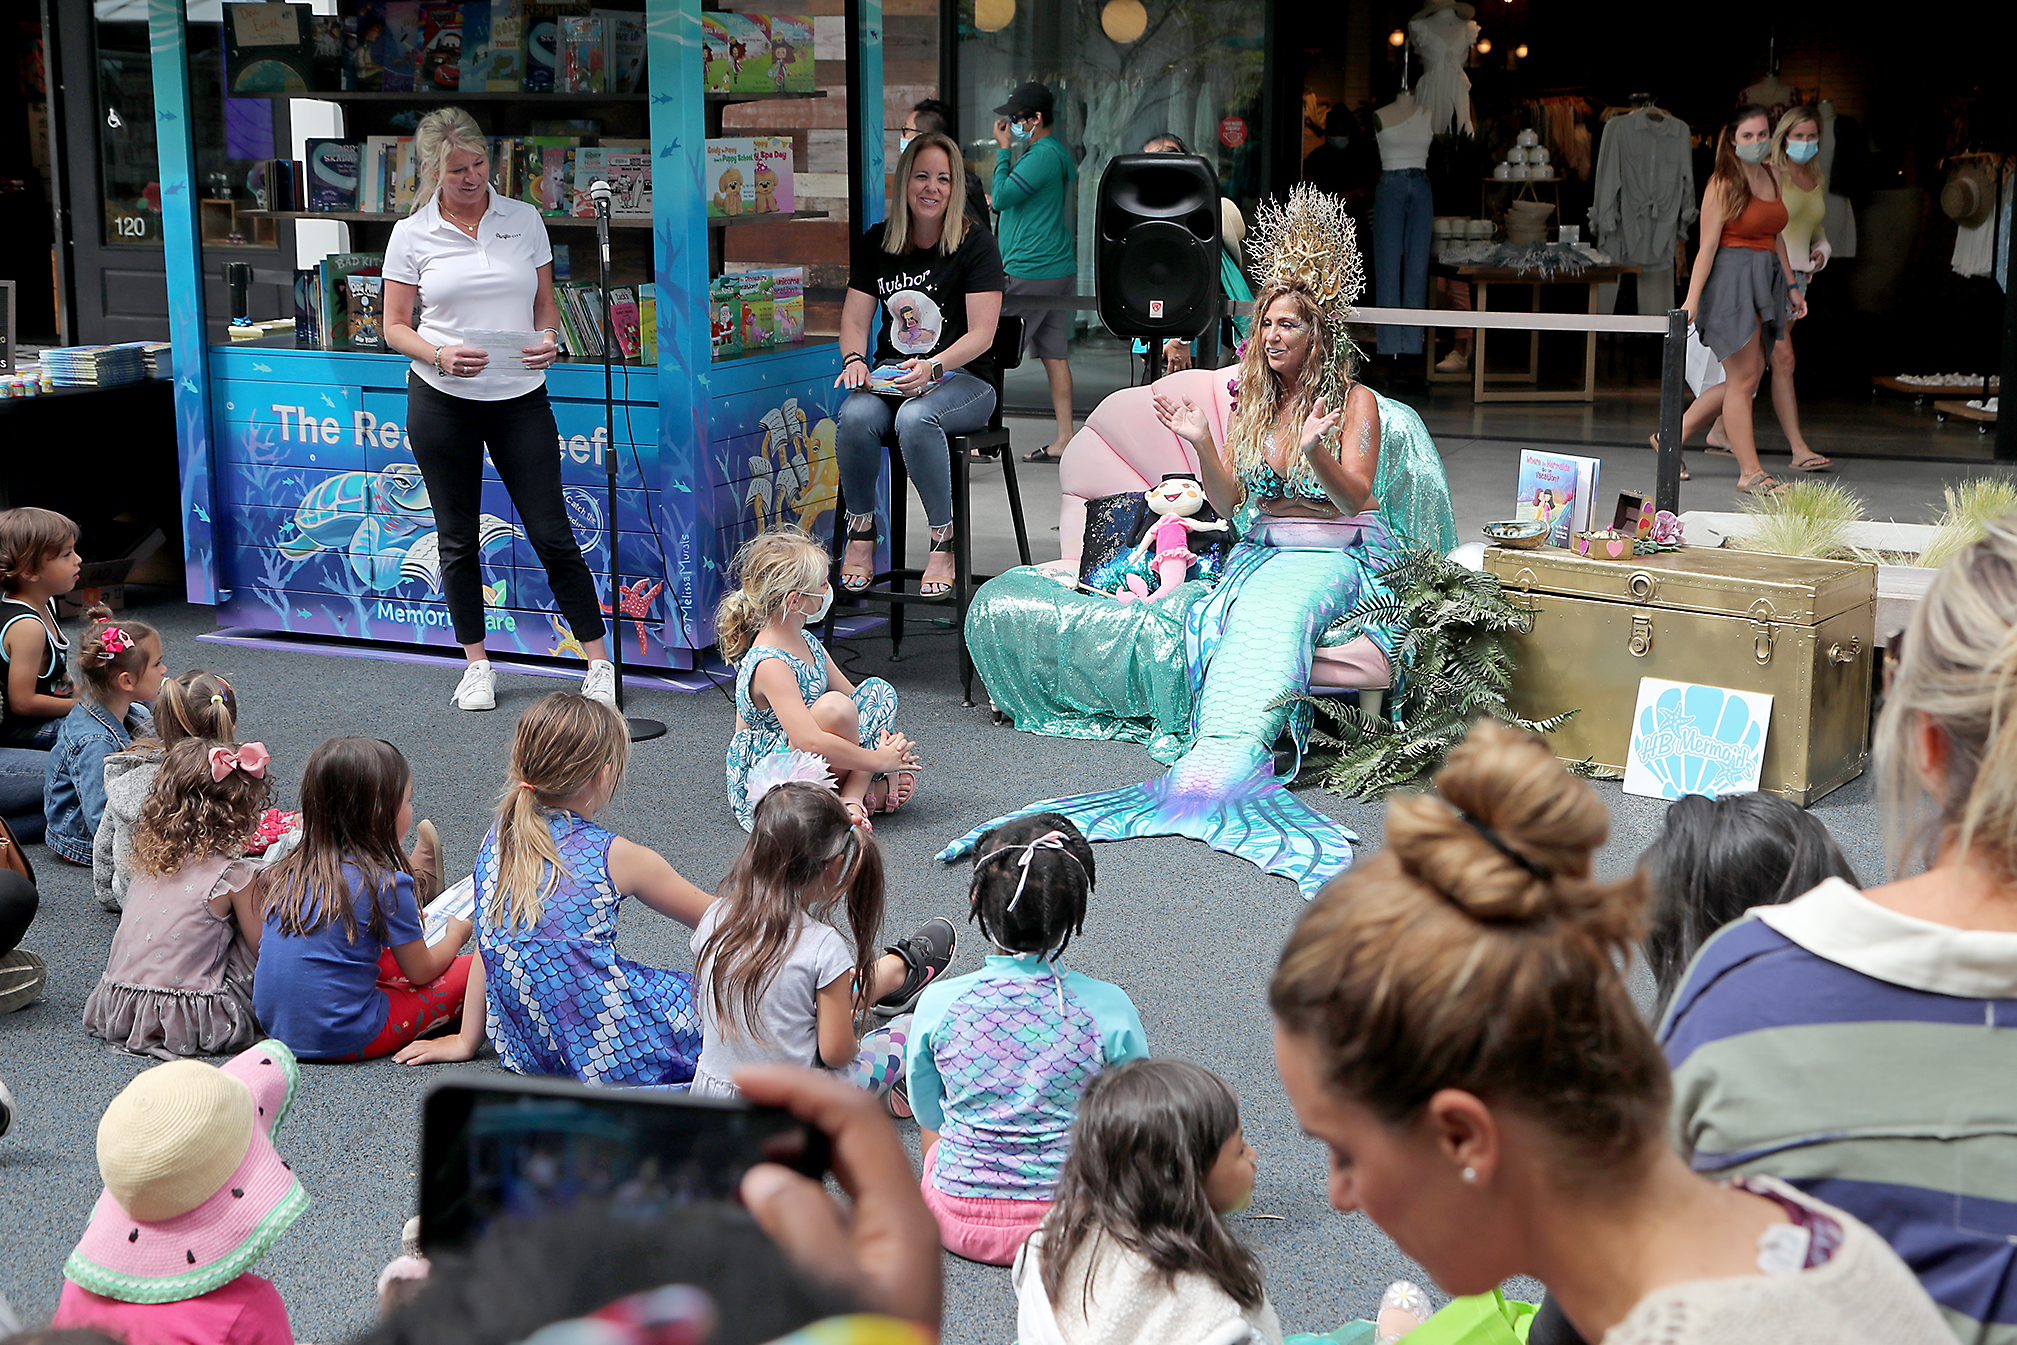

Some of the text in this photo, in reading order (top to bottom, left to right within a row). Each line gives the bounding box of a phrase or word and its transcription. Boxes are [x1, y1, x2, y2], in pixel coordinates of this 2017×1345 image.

[761, 150, 773, 160] Spa
[774, 150, 787, 161] Day
[114, 216, 146, 237] 120
[335, 257, 360, 270] BAD
[362, 256, 384, 267] KIT
[877, 269, 931, 295] Author
[270, 404, 341, 445] The
[558, 426, 608, 466] eef
[565, 495, 598, 525] Catch the
[377, 602, 453, 627] Memori
[1639, 726, 1757, 781] HB Mermaids
